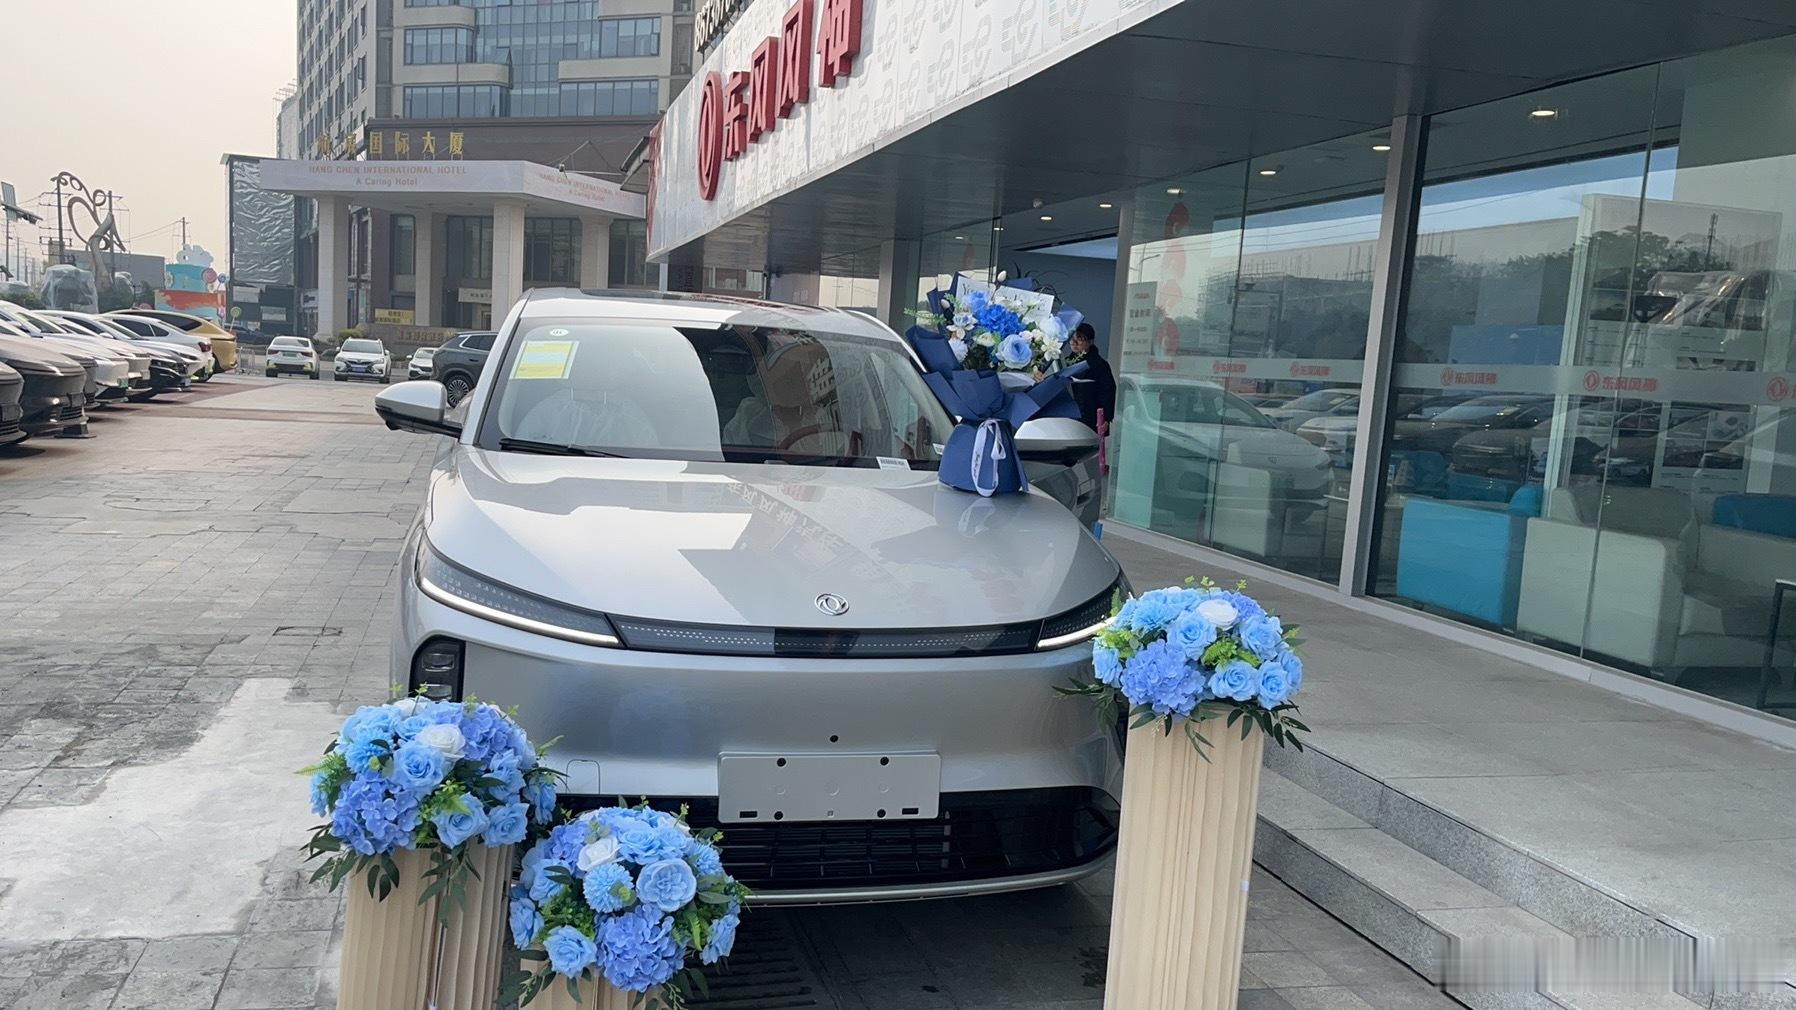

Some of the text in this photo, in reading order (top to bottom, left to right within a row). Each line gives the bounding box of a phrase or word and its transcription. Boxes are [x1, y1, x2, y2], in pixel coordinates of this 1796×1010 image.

[723, 0, 864, 162] 东风风神
[336, 166, 359, 174] CHEN
[363, 166, 434, 175] INTERNATIONAL
[437, 166, 467, 174] HOTEL
[365, 178, 392, 187] Caring
[395, 178, 418, 186] Hotel
